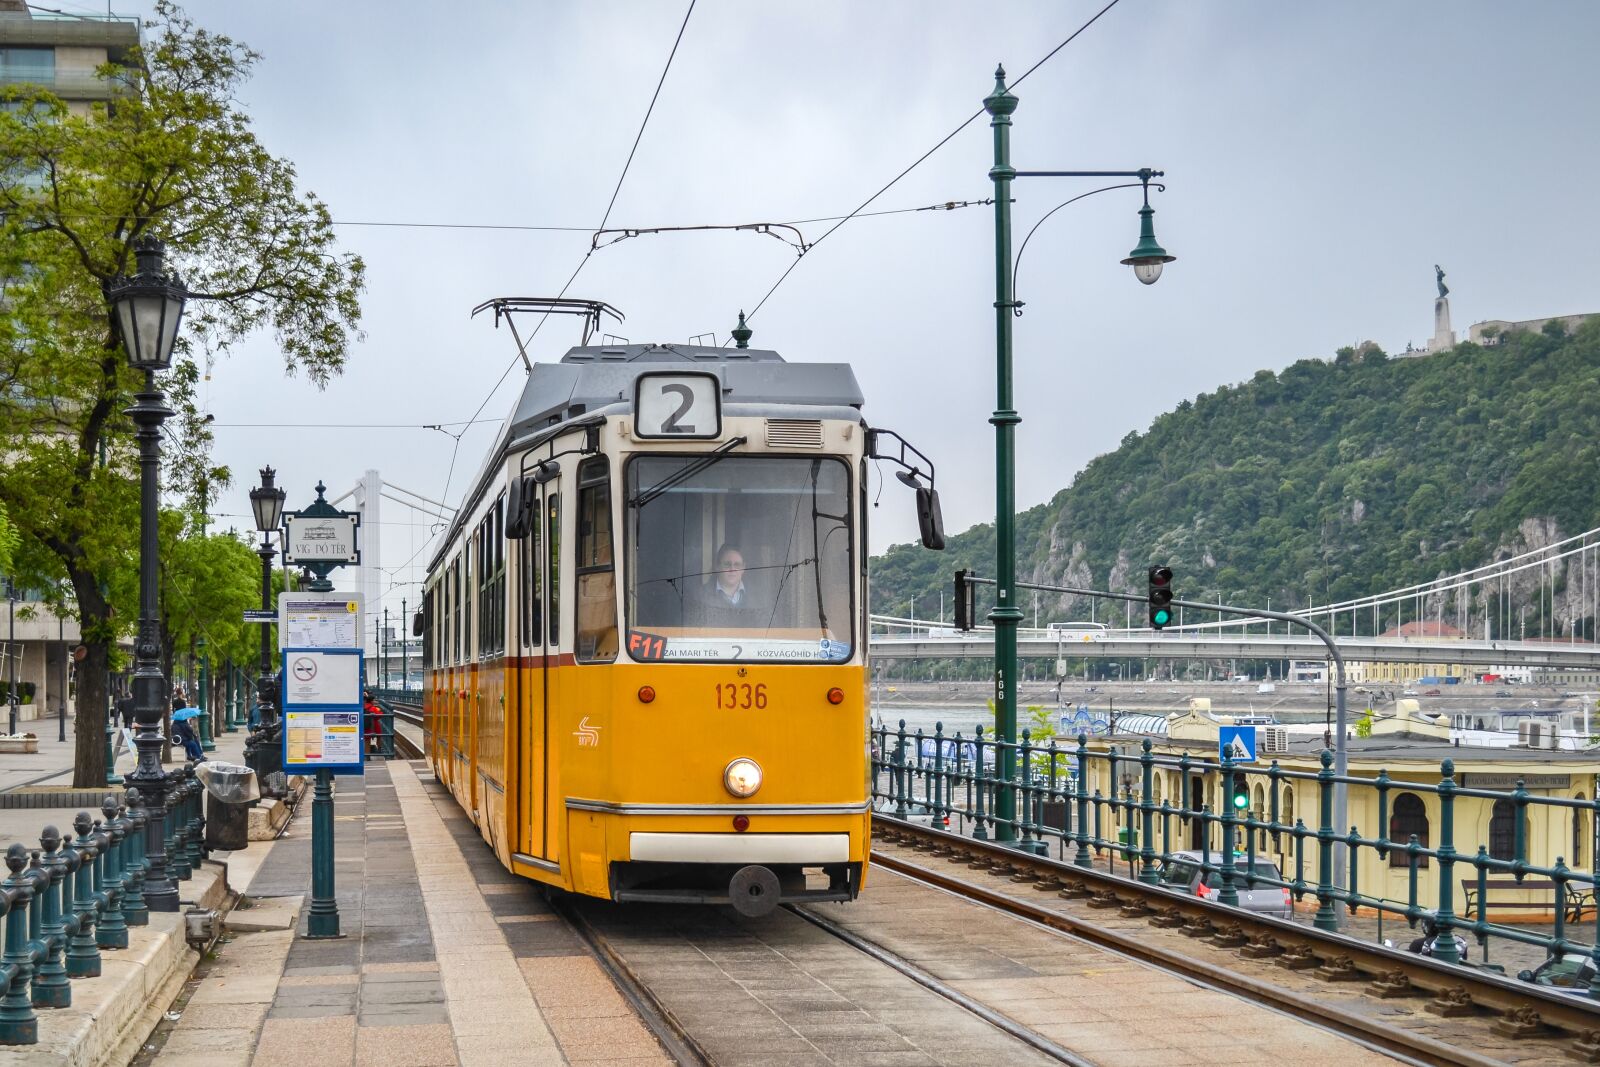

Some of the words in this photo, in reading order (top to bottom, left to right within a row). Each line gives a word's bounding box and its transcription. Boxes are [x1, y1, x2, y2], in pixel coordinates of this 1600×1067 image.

[661, 383, 695, 433] 2
[629, 634, 663, 659] F11
[680, 649, 701, 657] MARI
[704, 647, 719, 657] TÉR
[731, 645, 743, 660] 2
[716, 683, 768, 710] 1336
